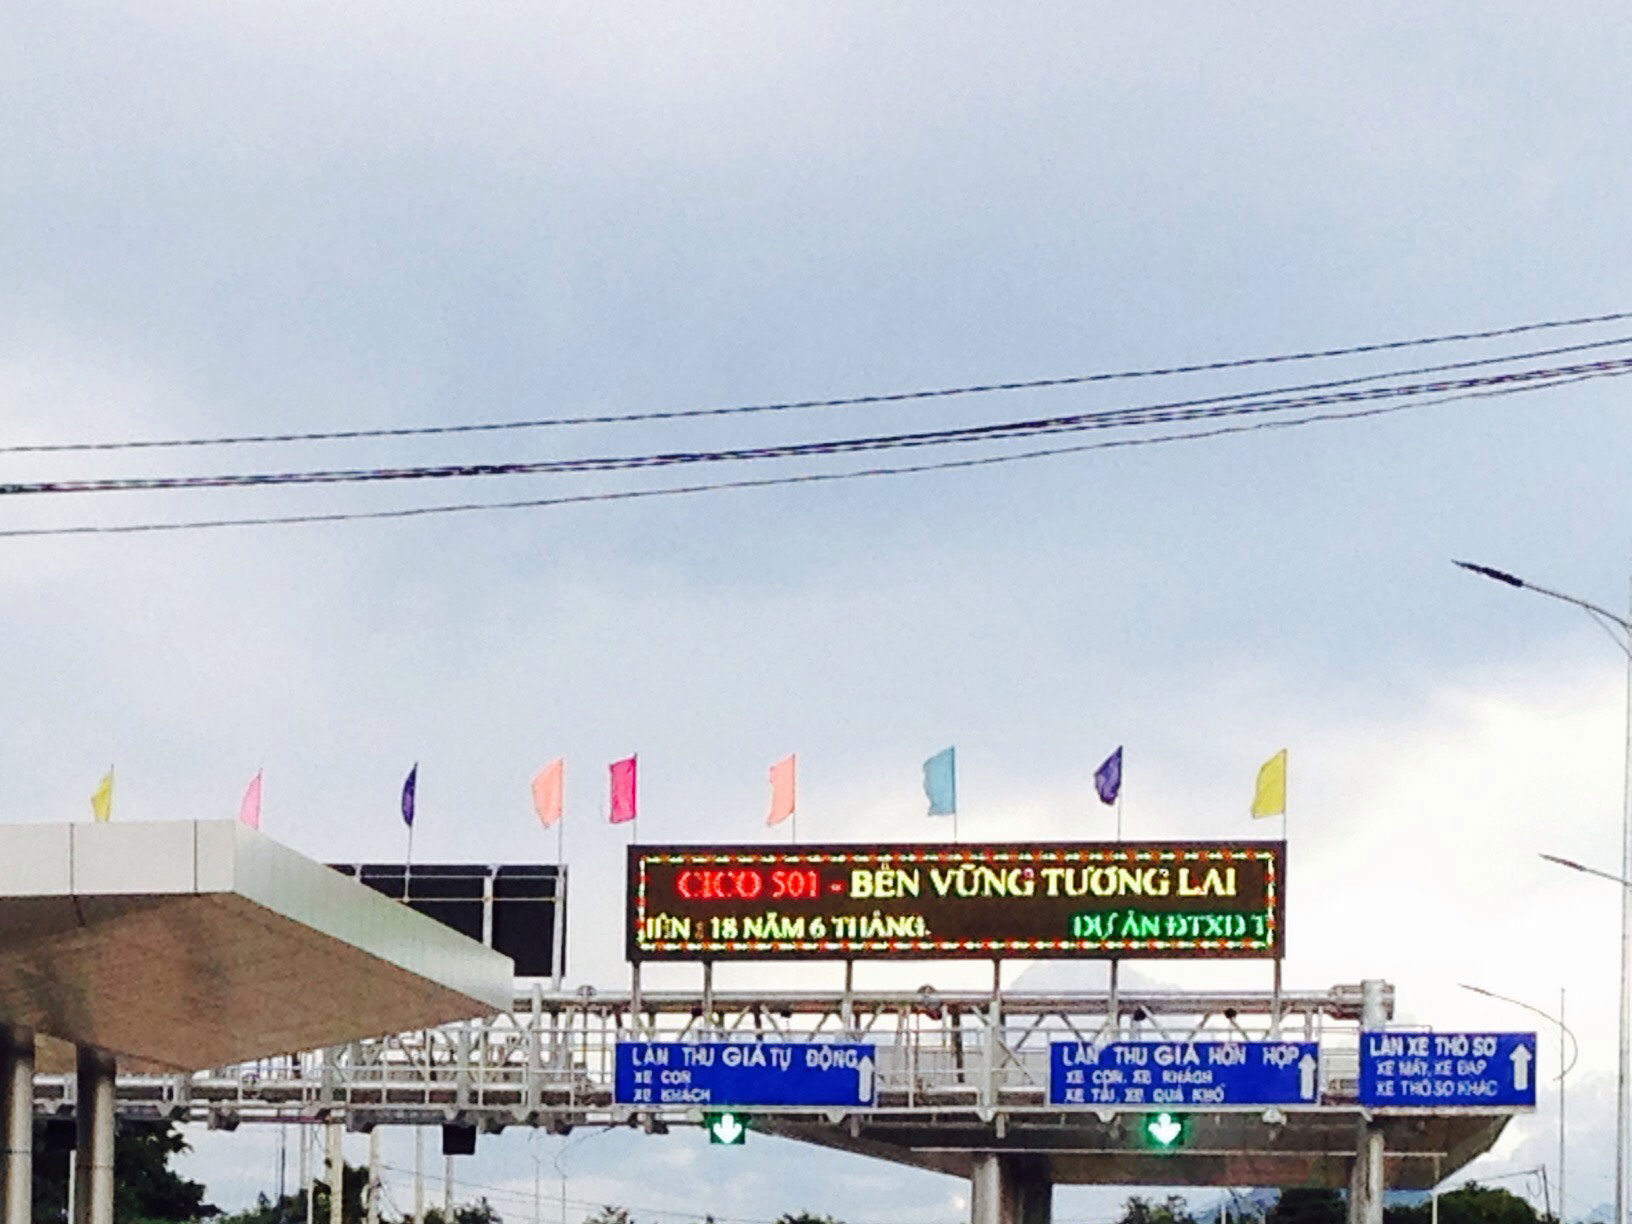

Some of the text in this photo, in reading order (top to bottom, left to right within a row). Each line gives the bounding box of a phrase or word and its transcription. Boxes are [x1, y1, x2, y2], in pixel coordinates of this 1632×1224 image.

[677, 870, 762, 899] CICO
[771, 870, 819, 899] 501
[1178, 868, 1237, 897] LAI
[710, 916, 738, 938] 18
[809, 917, 827, 938] 6
[681, 1046, 715, 1067] THU
[1113, 1046, 1148, 1066] THU
[1407, 1036, 1429, 1056] XE
